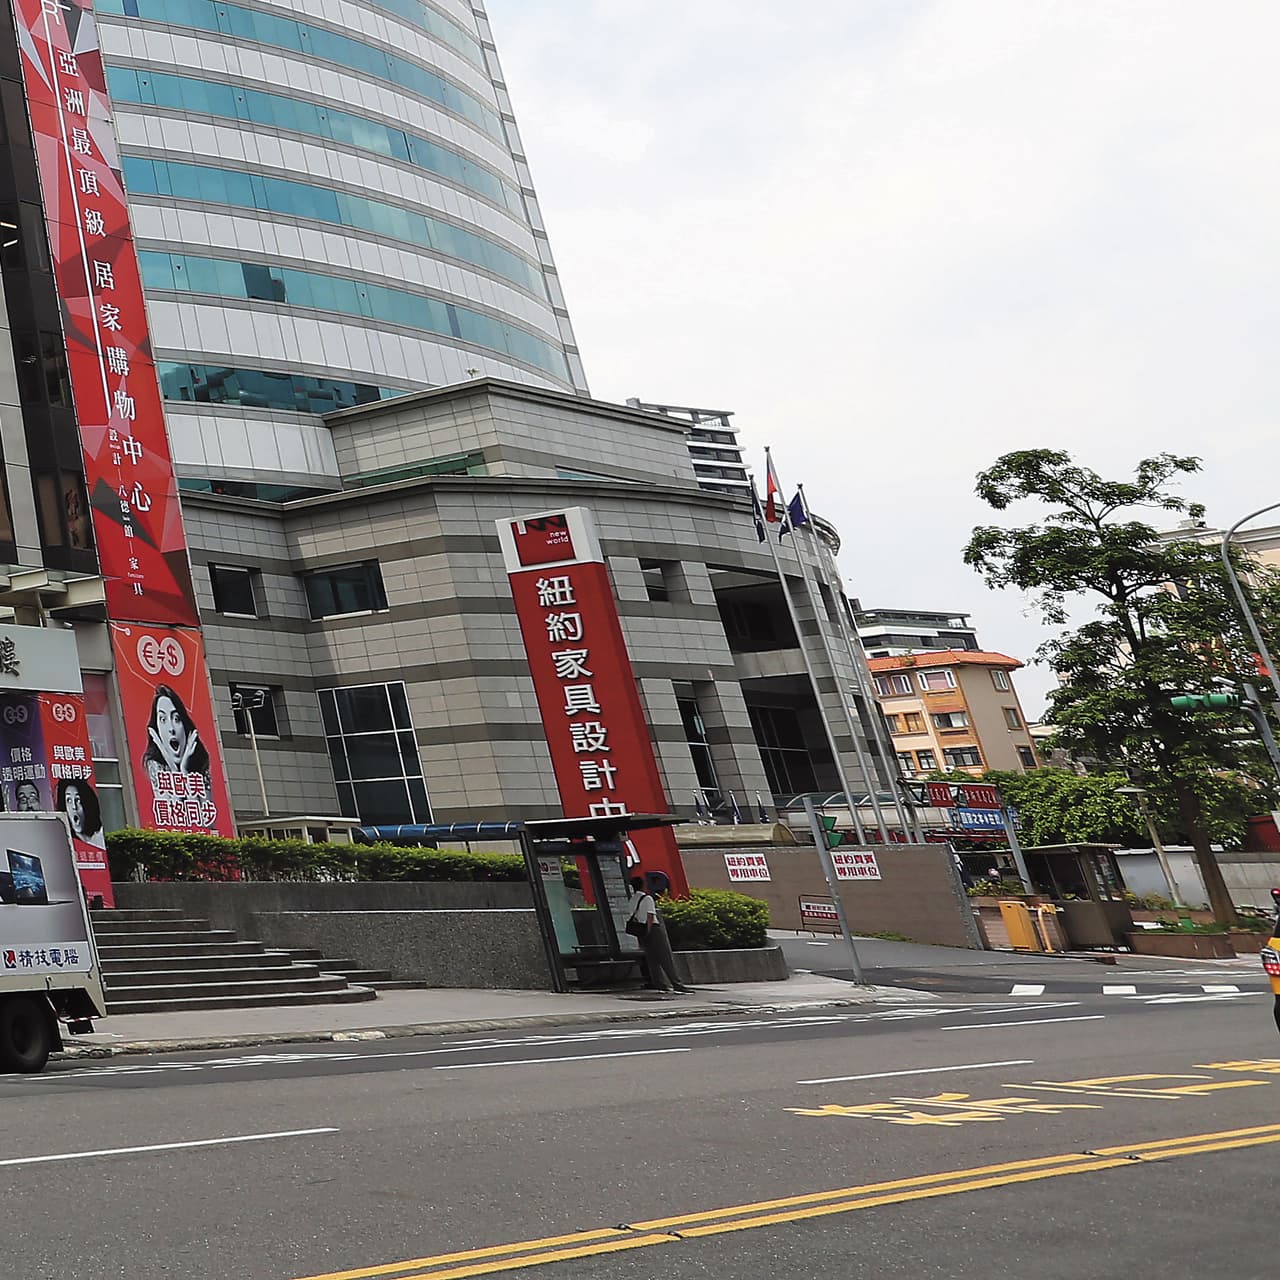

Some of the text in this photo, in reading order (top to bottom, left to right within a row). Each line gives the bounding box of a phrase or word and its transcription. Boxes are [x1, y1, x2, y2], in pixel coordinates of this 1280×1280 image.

[545, 535, 569, 545] world
[549, 530, 567, 538] new
[535, 576, 640, 867] 紐約家具設計中
[10, 746, 32, 763] 價格
[53, 745, 86, 761] 與歐美
[51, 763, 93, 780] 價格同步
[156, 770, 207, 798] 與歐美
[152, 799, 218, 828] 價格同步
[19, 948, 79, 968] 精技電腦
